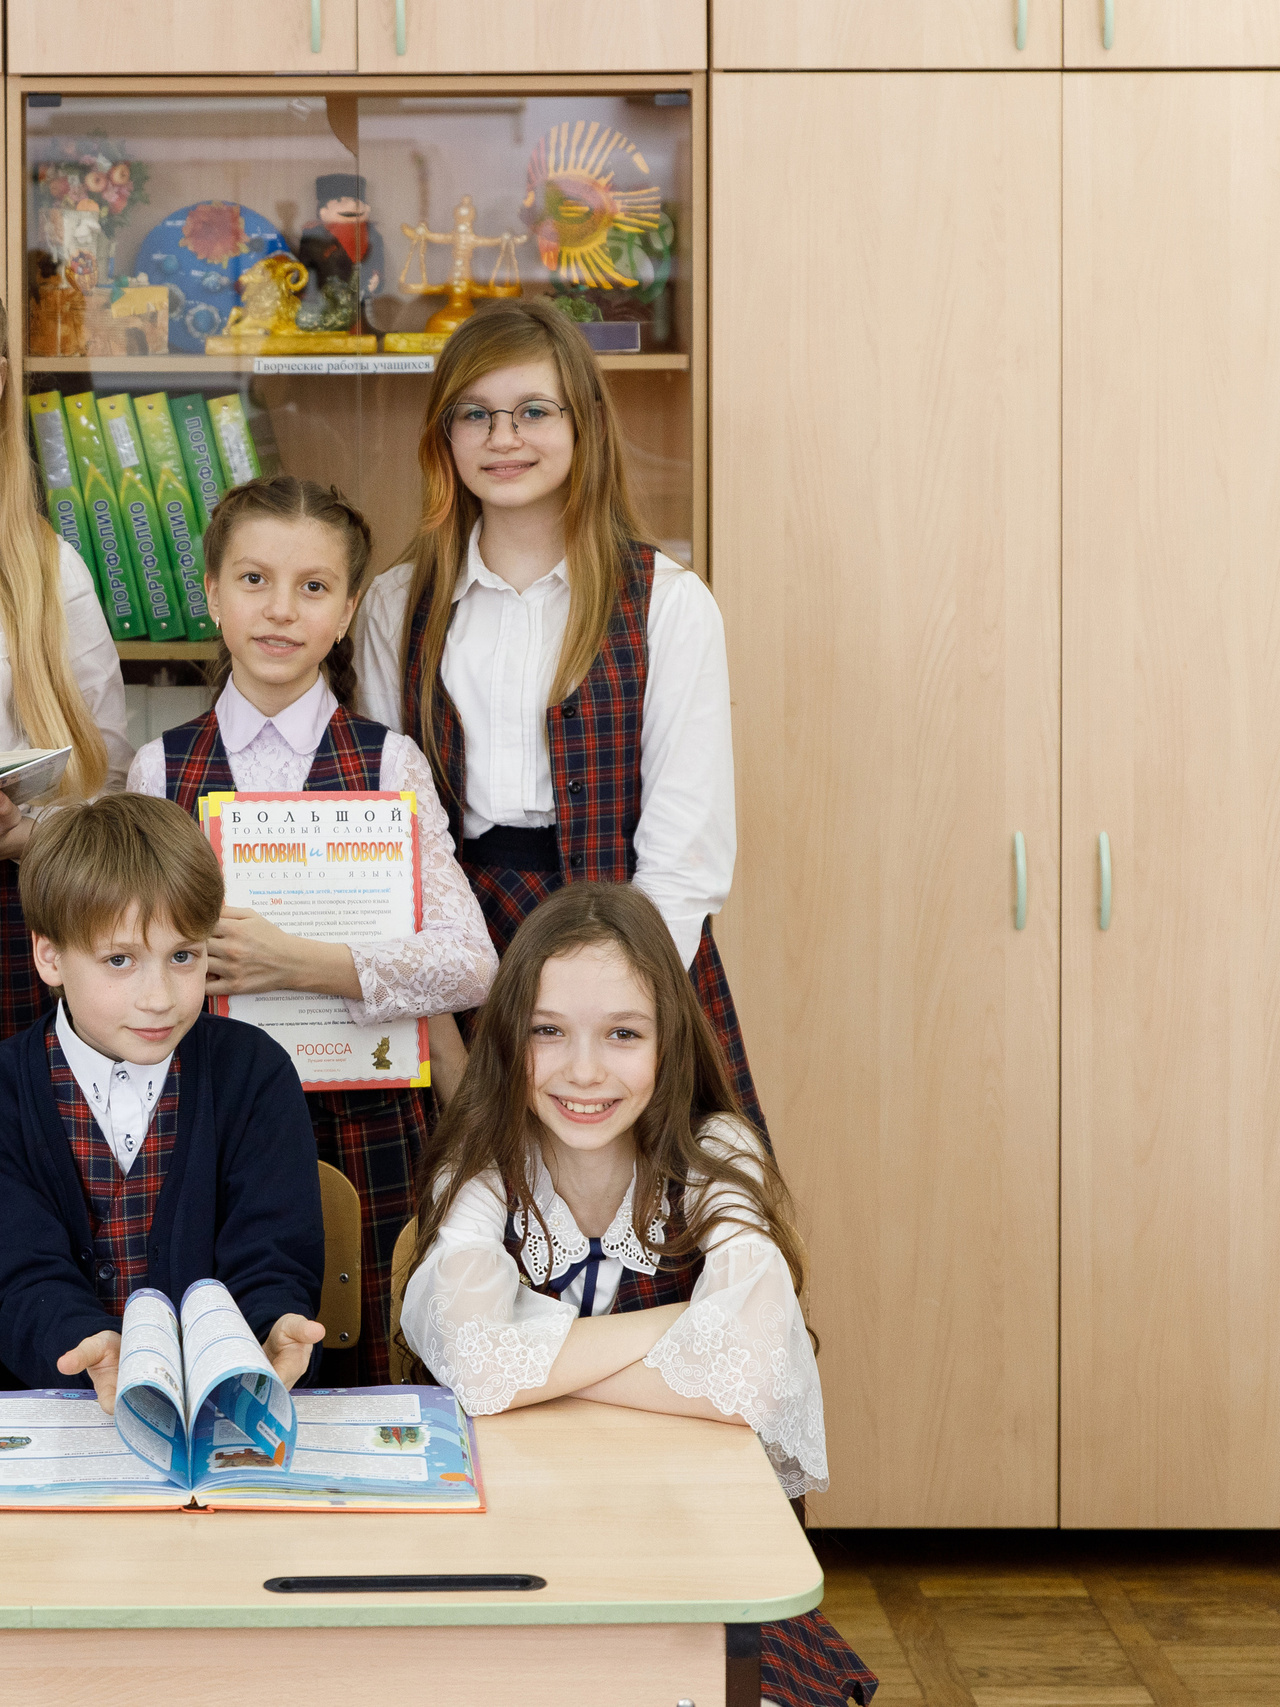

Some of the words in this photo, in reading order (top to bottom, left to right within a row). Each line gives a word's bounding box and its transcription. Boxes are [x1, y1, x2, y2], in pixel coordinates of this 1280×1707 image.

[256, 360, 322, 373] Творческие
[327, 360, 369, 373] работы
[373, 360, 431, 373] учащихся
[184, 416, 222, 520] ПОРТФОЛ
[94, 499, 132, 617] ПОРТФОЛИО
[129, 500, 170, 619] ПОРТФОЛИО
[166, 500, 208, 619] ПОРТФОЛИО
[232, 808, 402, 823] БОЛЬШОЙ
[232, 825, 321, 835] ТОЛКОВЫЙ
[333, 825, 403, 834] СЛОВАРЬ
[233, 843, 308, 866] ПОСЛОВИЦ
[309, 847, 323, 857] и
[326, 841, 404, 862] ПОГОВОРОК
[236, 871, 326, 879] РУССКОГО
[348, 870, 403, 878] ЯЗЫКА
[270, 898, 283, 906] 300
[296, 1043, 352, 1056] РООССА
